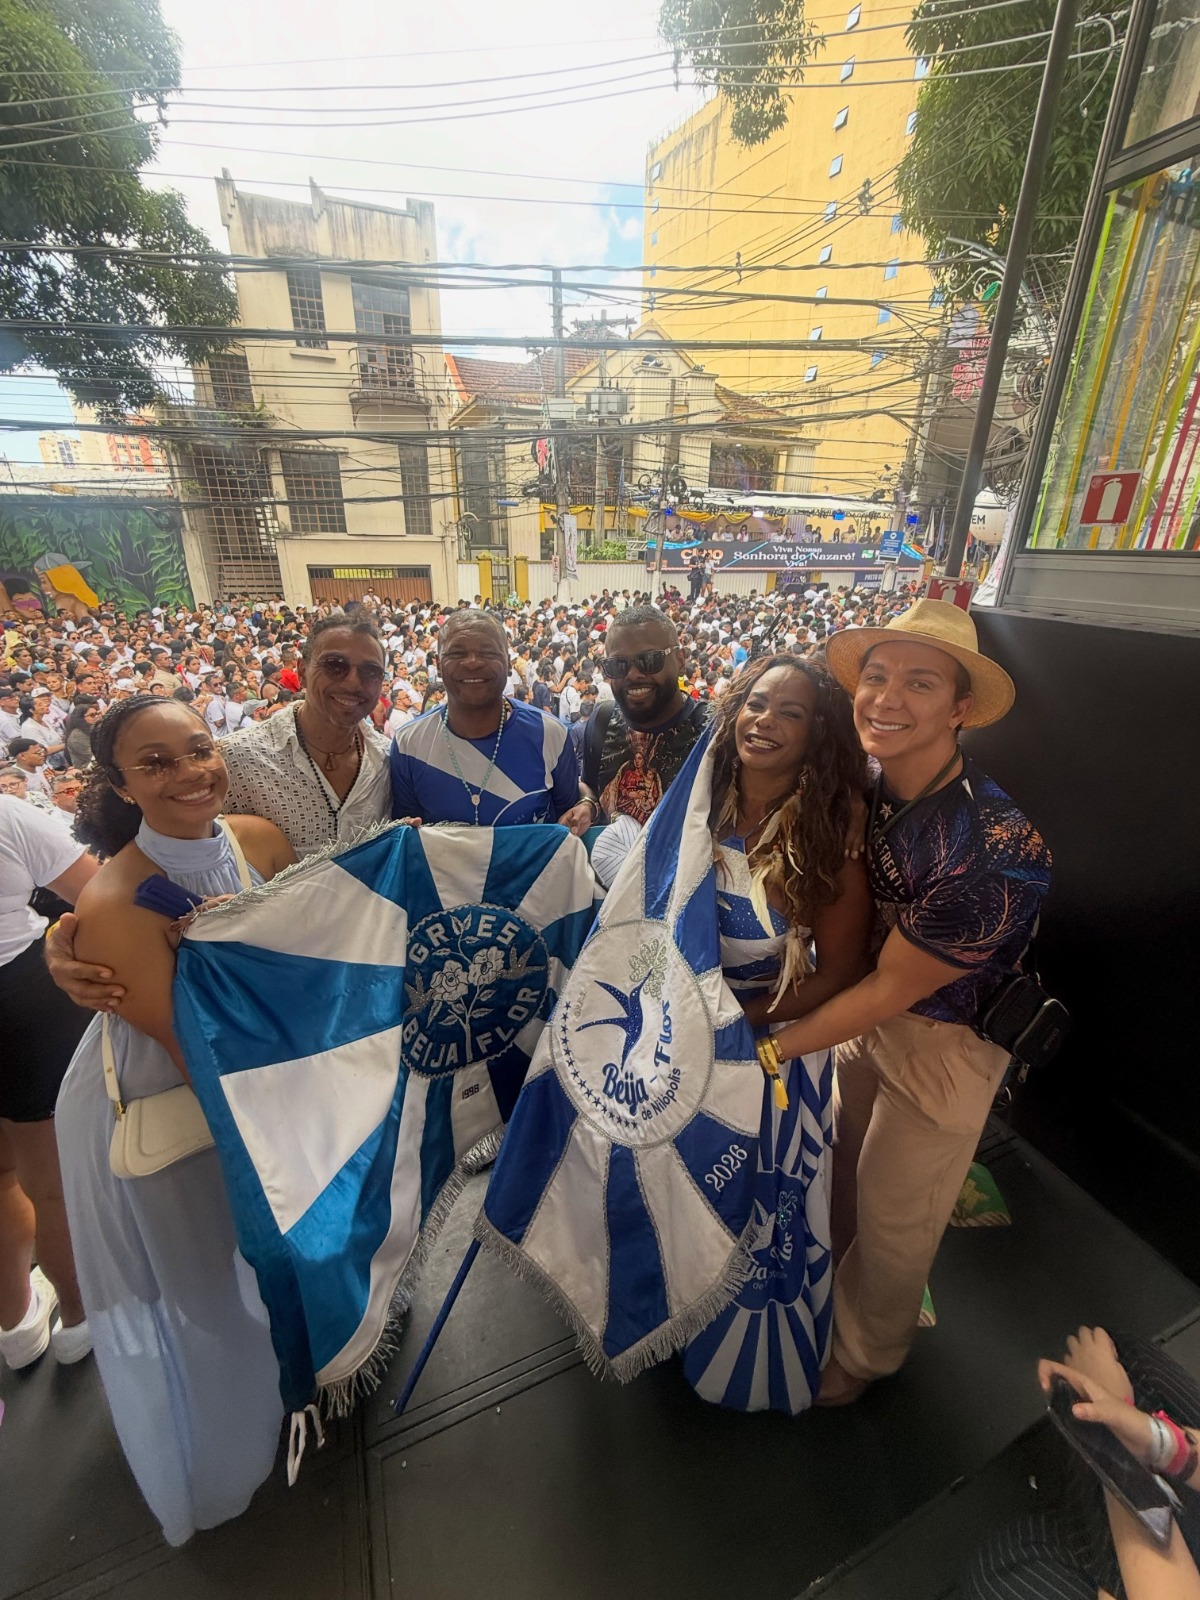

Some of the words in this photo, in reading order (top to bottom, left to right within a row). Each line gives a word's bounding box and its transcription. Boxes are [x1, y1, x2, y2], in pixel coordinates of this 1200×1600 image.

[772, 545, 793, 553] Viva
[402, 1016, 459, 1069] BEIJA
[475, 987, 541, 1055] FLOR
[461, 1083, 480, 1100] 1998
[641, 1106, 653, 1121] de
[651, 1067, 682, 1116] Nilópolis
[705, 1144, 748, 1193] 2026
